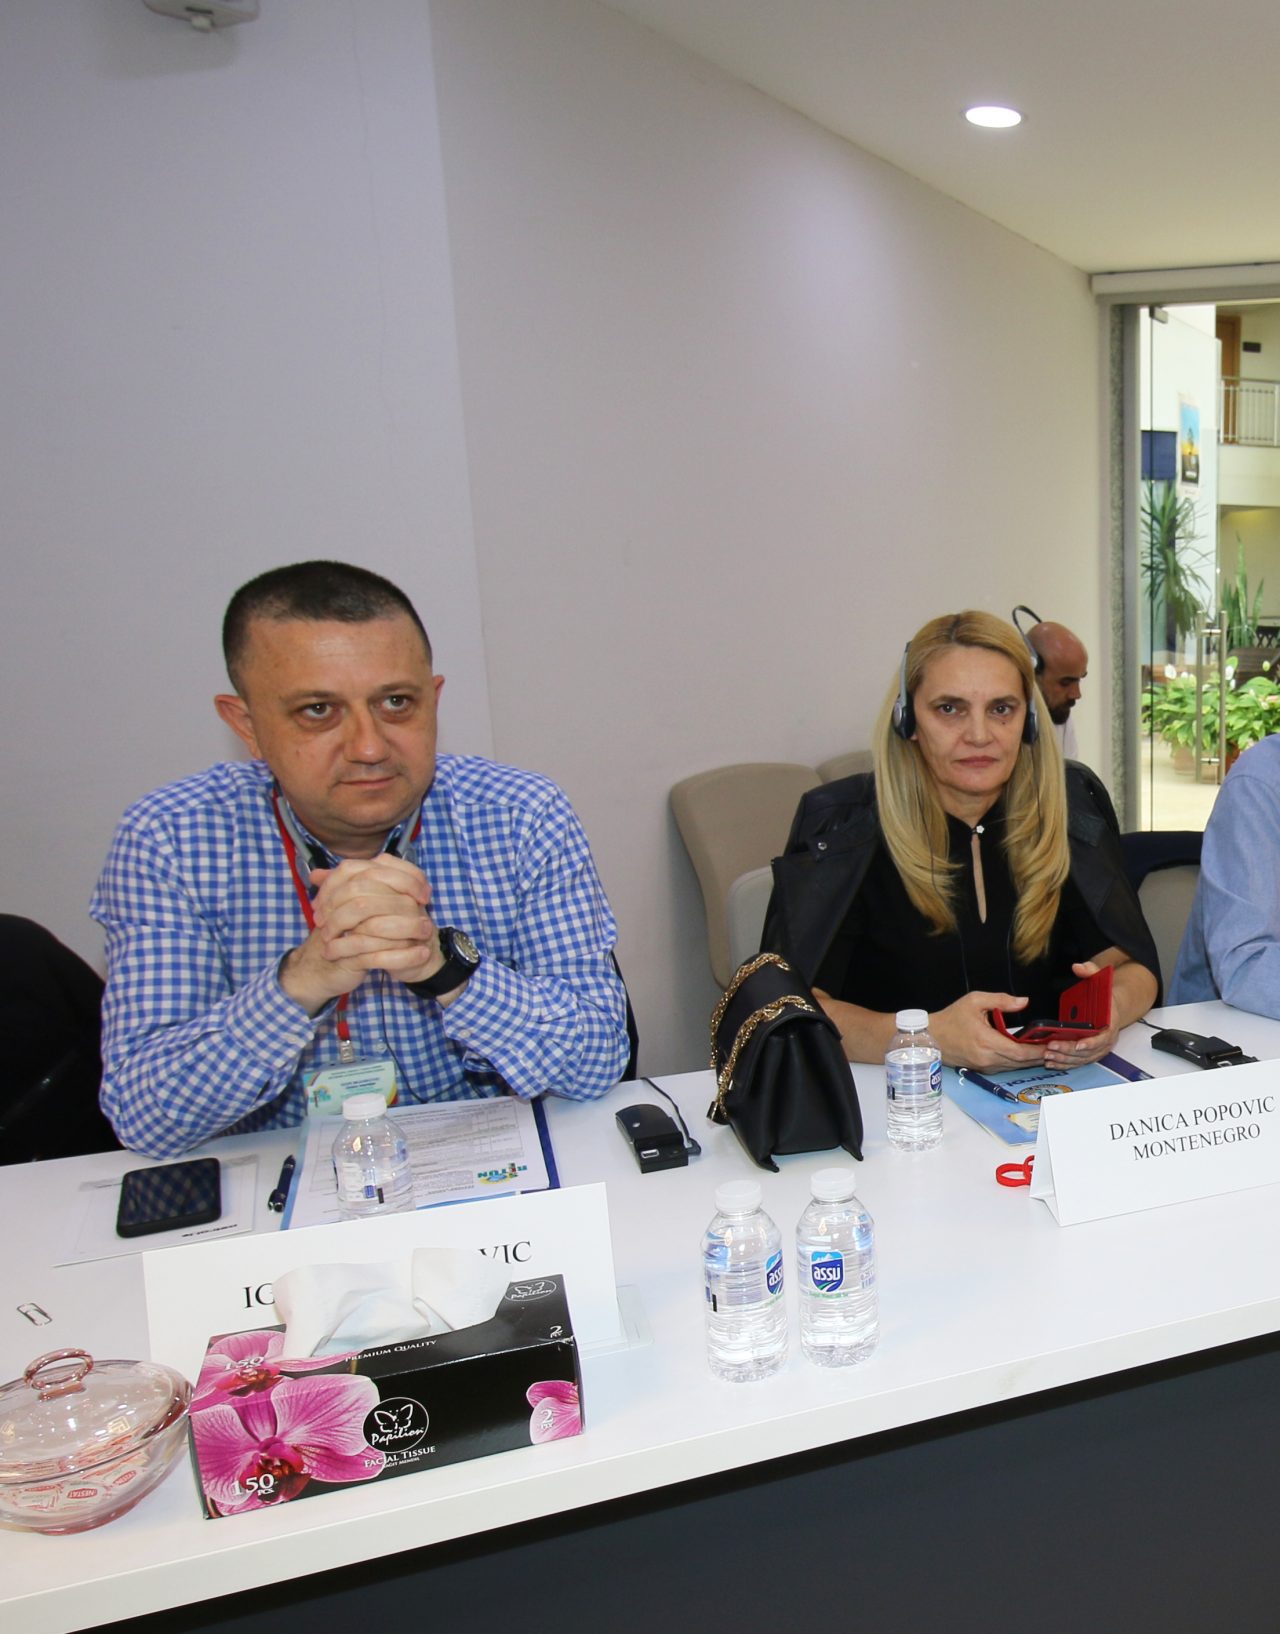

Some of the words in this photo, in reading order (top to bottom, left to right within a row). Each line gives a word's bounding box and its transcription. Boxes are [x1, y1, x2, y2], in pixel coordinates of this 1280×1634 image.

[1109, 1112, 1189, 1141] DANICA
[1192, 1095, 1277, 1126] POPOVIC
[1133, 1123, 1261, 1161] MONTENEGRO
[242, 1282, 275, 1309] IG
[345, 1347, 392, 1362] PREMIUM
[393, 1339, 438, 1352] QUALITY
[541, 1409, 554, 1424] 2
[364, 1454, 400, 1469] FACIAL
[401, 1446, 437, 1460] TISSUE
[230, 1473, 275, 1497] 150
